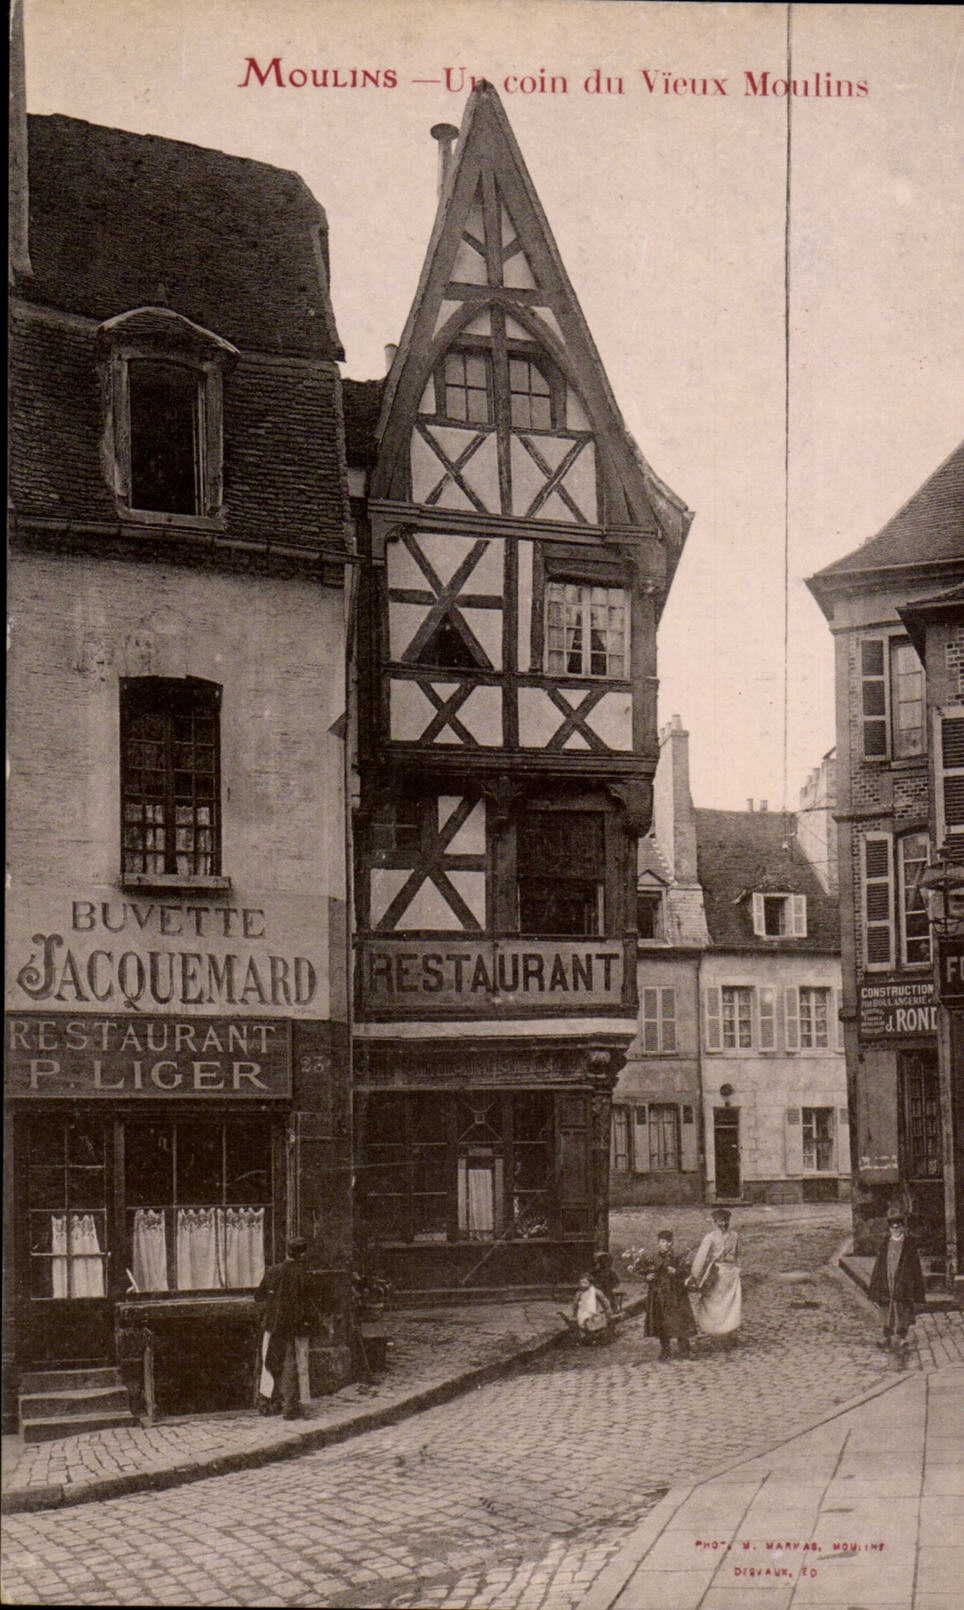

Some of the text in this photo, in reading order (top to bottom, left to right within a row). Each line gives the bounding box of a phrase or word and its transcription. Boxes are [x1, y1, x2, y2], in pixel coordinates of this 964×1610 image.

[71, 901, 266, 939] BUVETTE
[16, 933, 318, 1011] JACQUEMARD
[369, 953, 620, 993] RESTAURANT
[9, 1021, 276, 1053] RESTAURANT
[94, 1059, 270, 1091] LIGER
